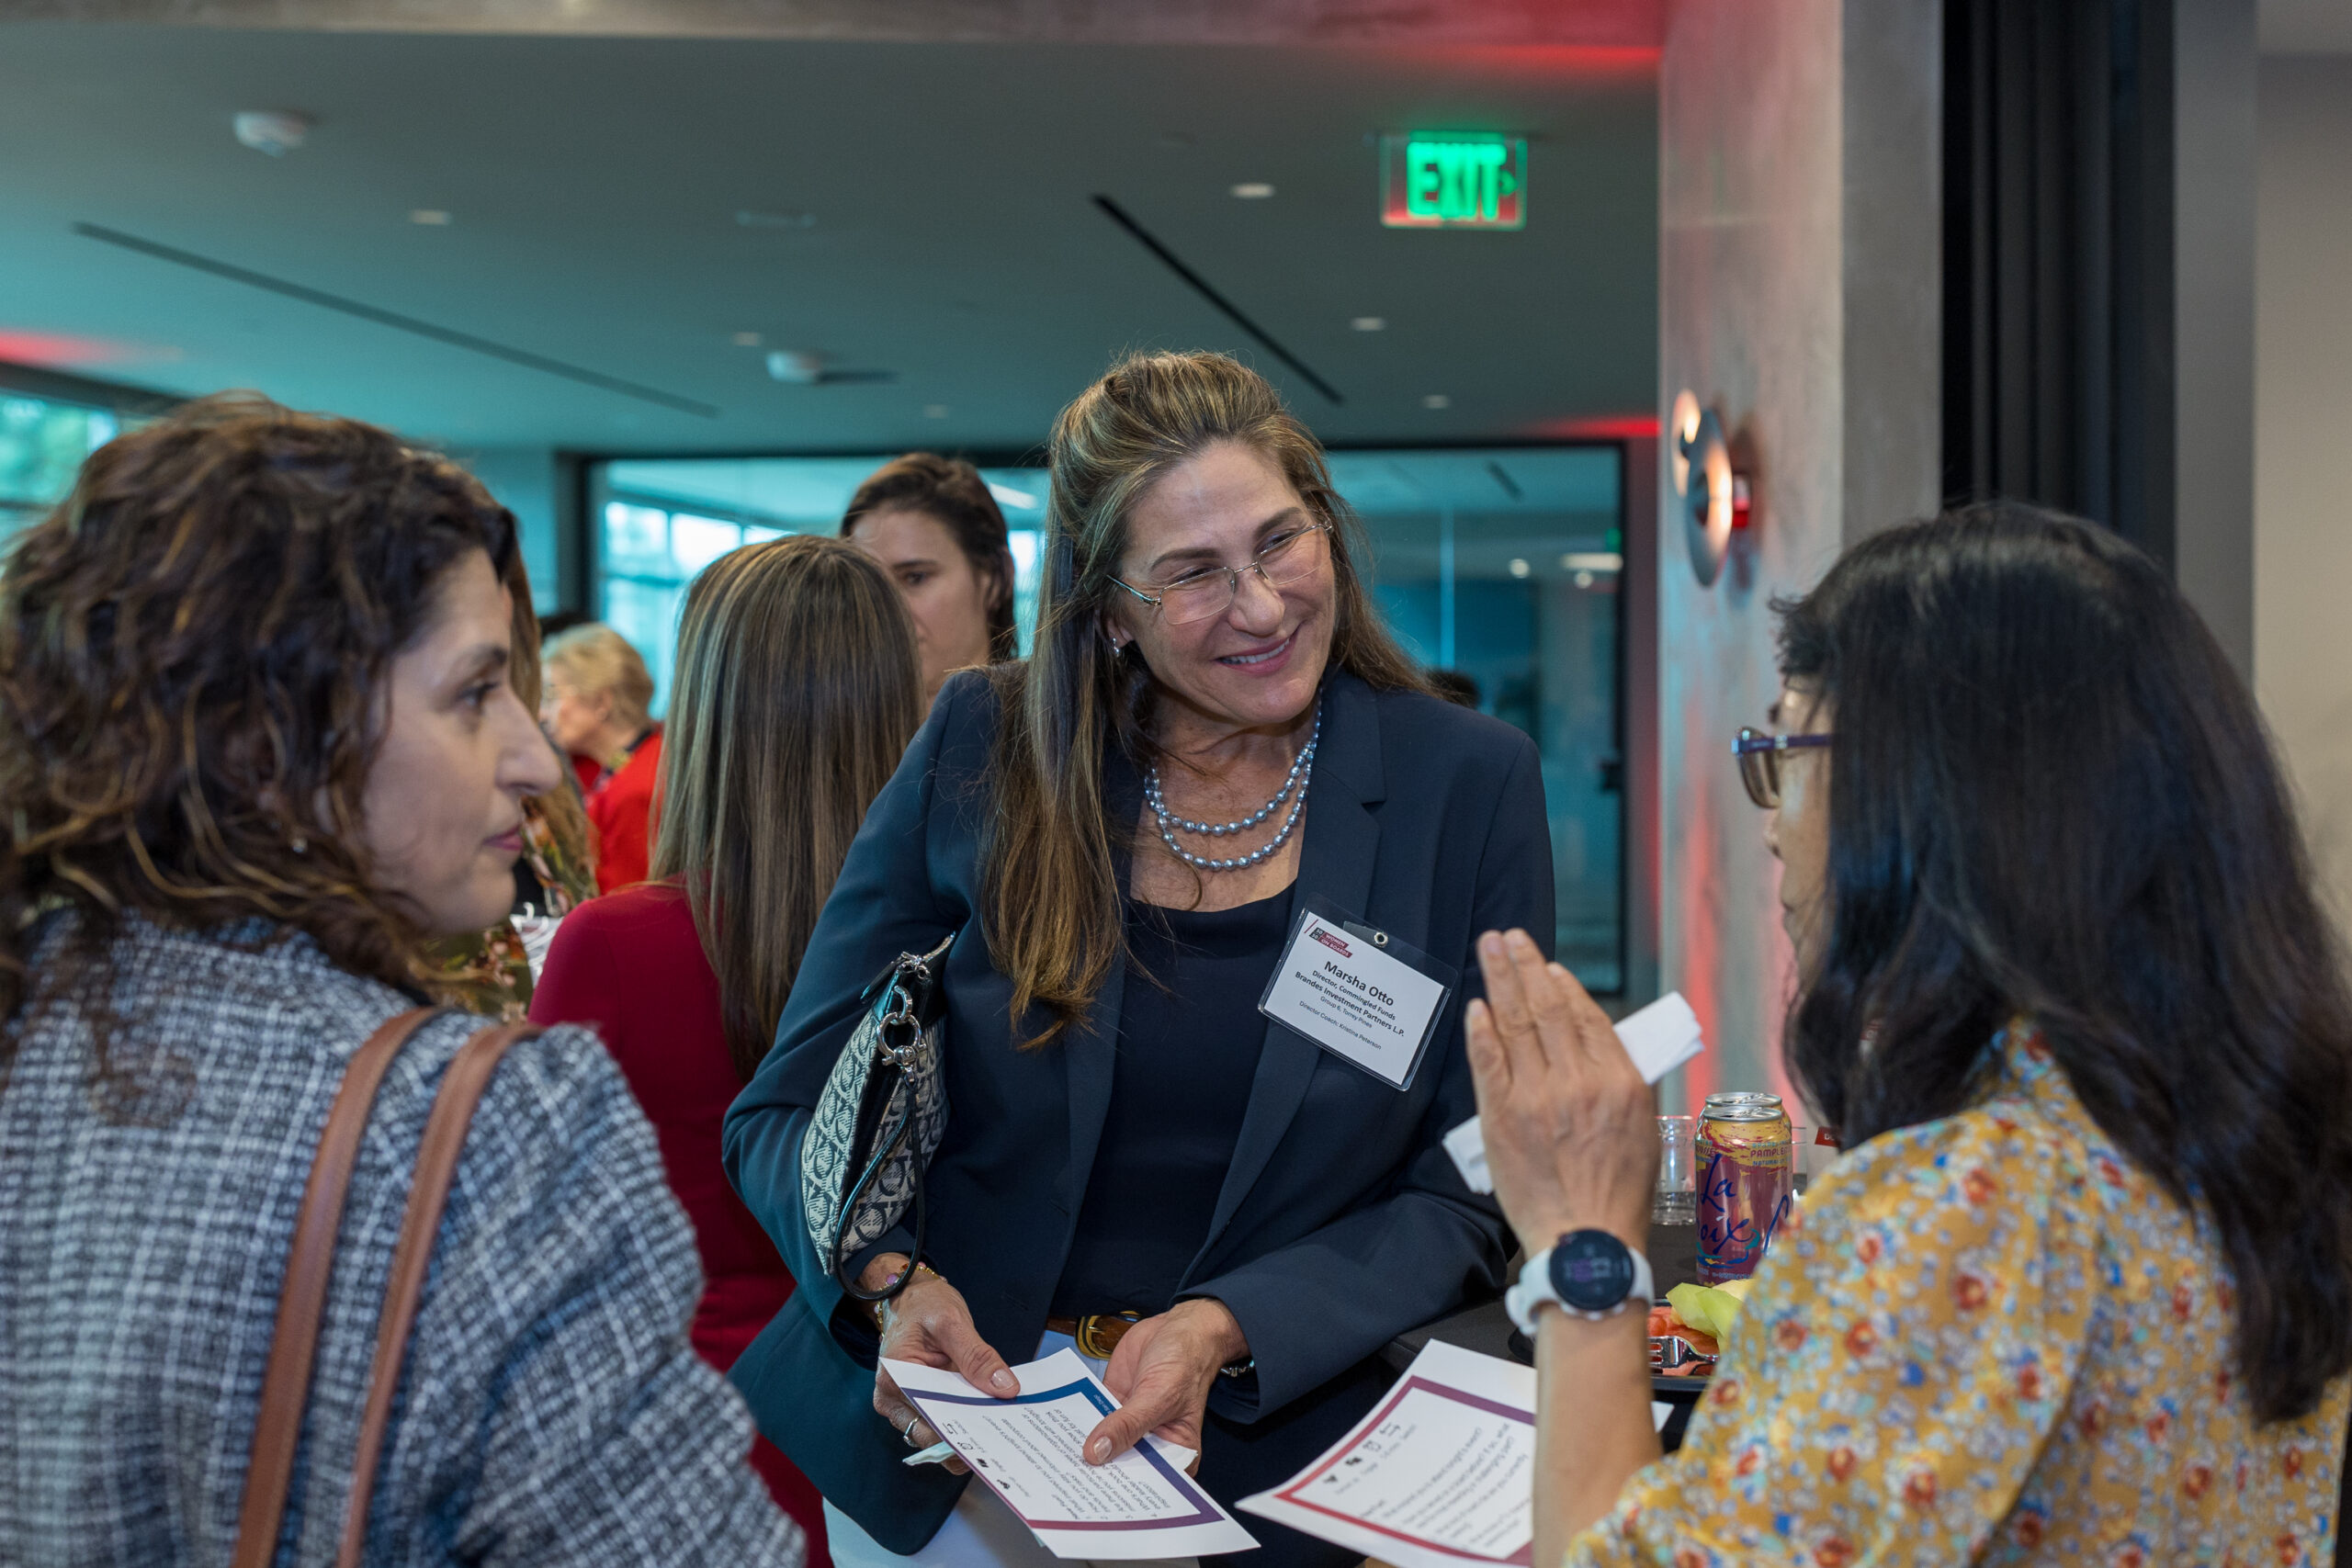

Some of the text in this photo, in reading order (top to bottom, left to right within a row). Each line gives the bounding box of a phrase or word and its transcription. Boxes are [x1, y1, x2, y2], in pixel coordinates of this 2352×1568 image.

[1407, 141, 1507, 220] EXIT
[1320, 938, 1330, 947] ON
[1329, 942, 1350, 957] BOARDS
[1326, 933, 1346, 948] WOMEN
[1295, 972, 1404, 1036] Brandes Investment Partners L.P.
[1313, 970, 1395, 1021] Director, Commingled Funds
[1325, 961, 1393, 1006] Marsha Otto
[1299, 1001, 1320, 1015] Director
[1339, 1023, 1358, 1037] Kristina
[1359, 1034, 1381, 1050] Peterson
[1320, 996, 1336, 1008] Group
[1343, 1009, 1358, 1021] Torrey
[1358, 1017, 1372, 1028] Pines
[1702, 1153, 1736, 1213] La
